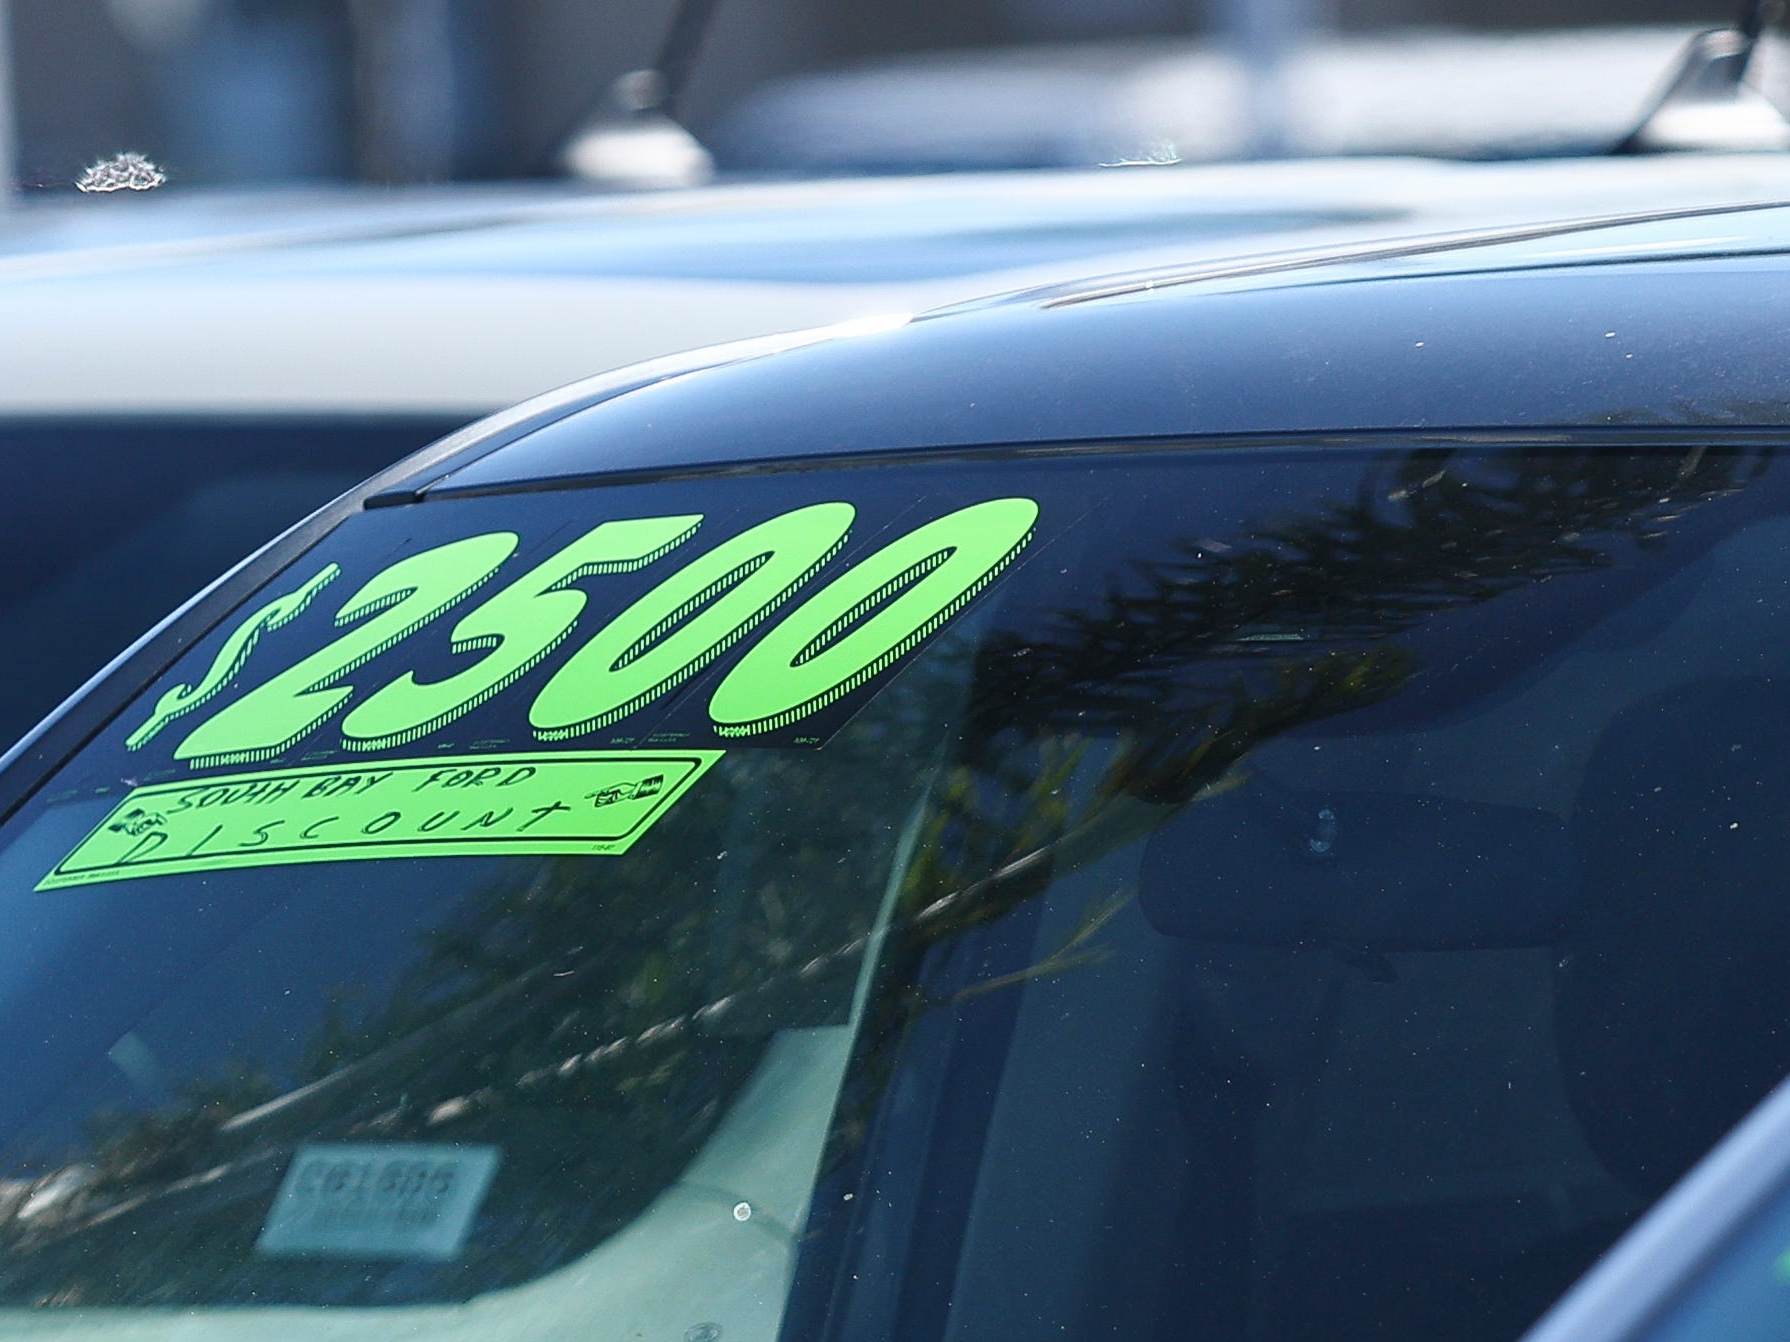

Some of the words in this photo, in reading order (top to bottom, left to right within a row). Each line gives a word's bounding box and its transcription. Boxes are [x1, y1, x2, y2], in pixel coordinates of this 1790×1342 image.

[124, 497, 1040, 770] $2500
[166, 779, 300, 815] SOUTH
[301, 770, 394, 800] BAY
[411, 765, 537, 793] FORD
